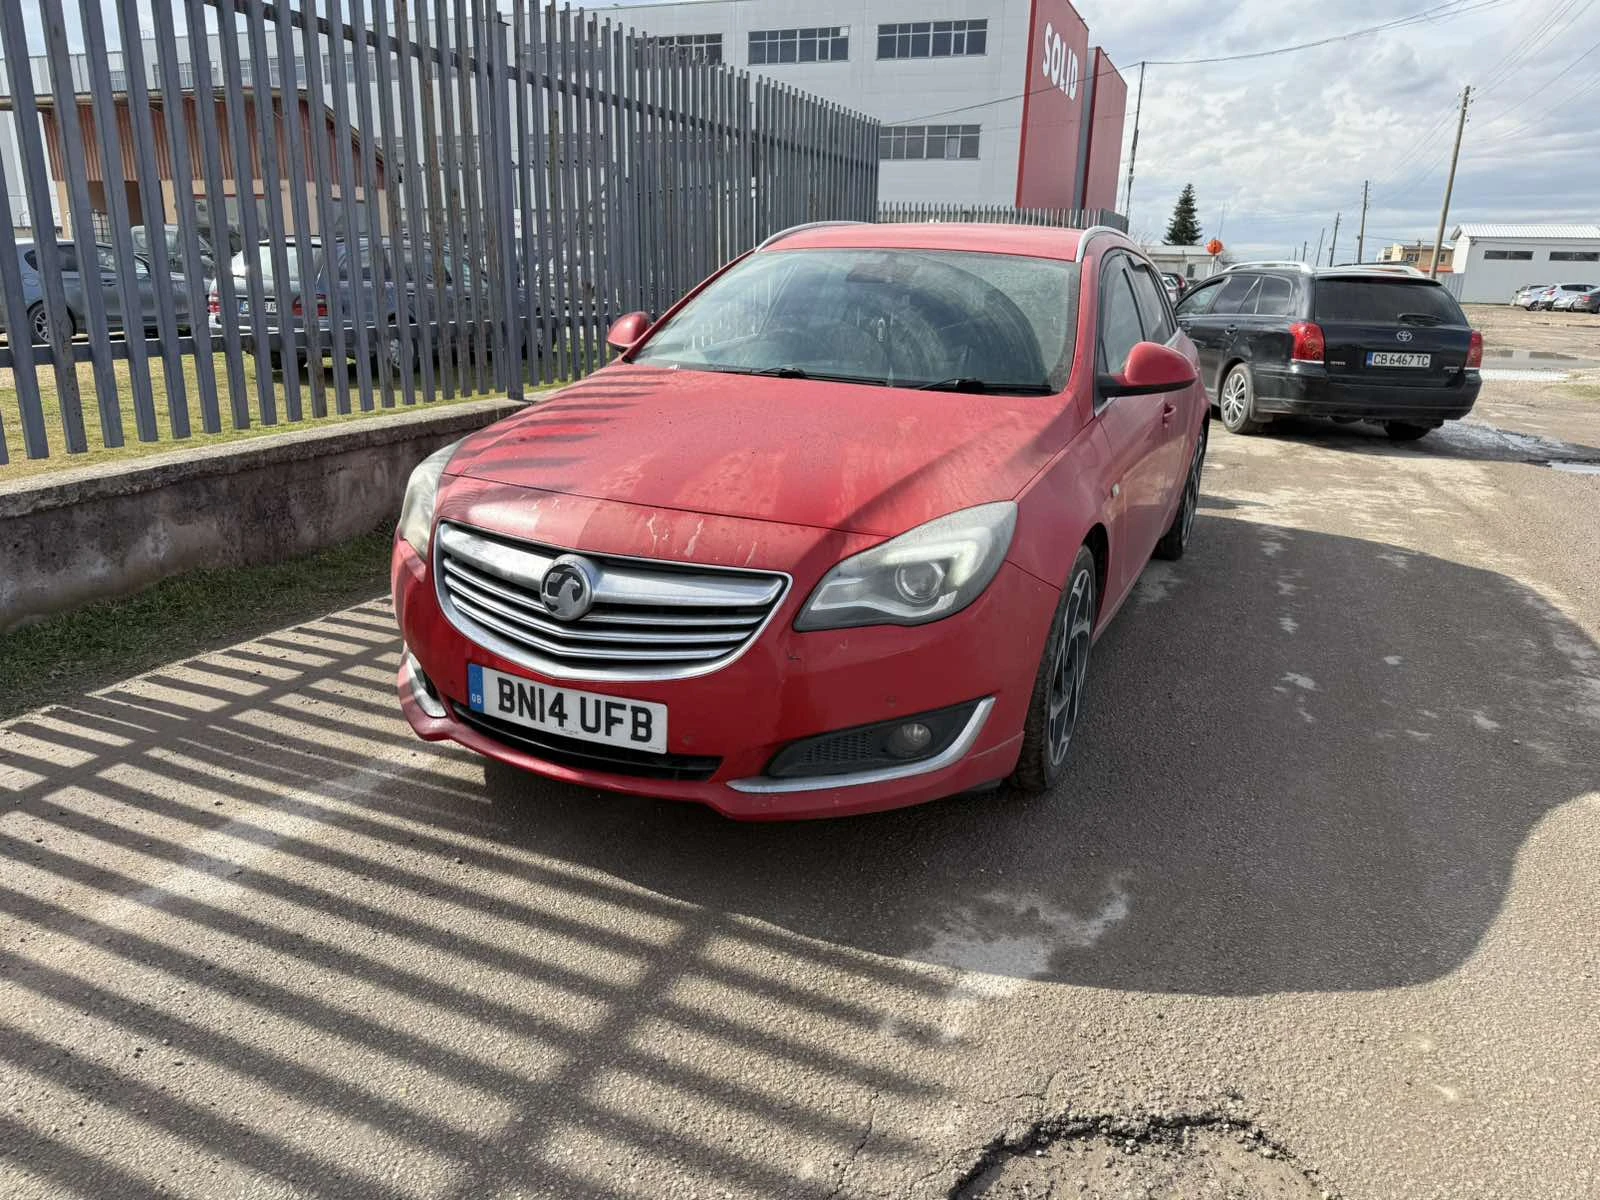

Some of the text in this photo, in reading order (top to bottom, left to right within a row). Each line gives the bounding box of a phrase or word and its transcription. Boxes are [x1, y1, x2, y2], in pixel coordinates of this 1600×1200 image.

[1042, 22, 1078, 101] SOLID
[1374, 353, 1430, 367] CB 6467 TC
[497, 676, 653, 743] BN14 UFB
